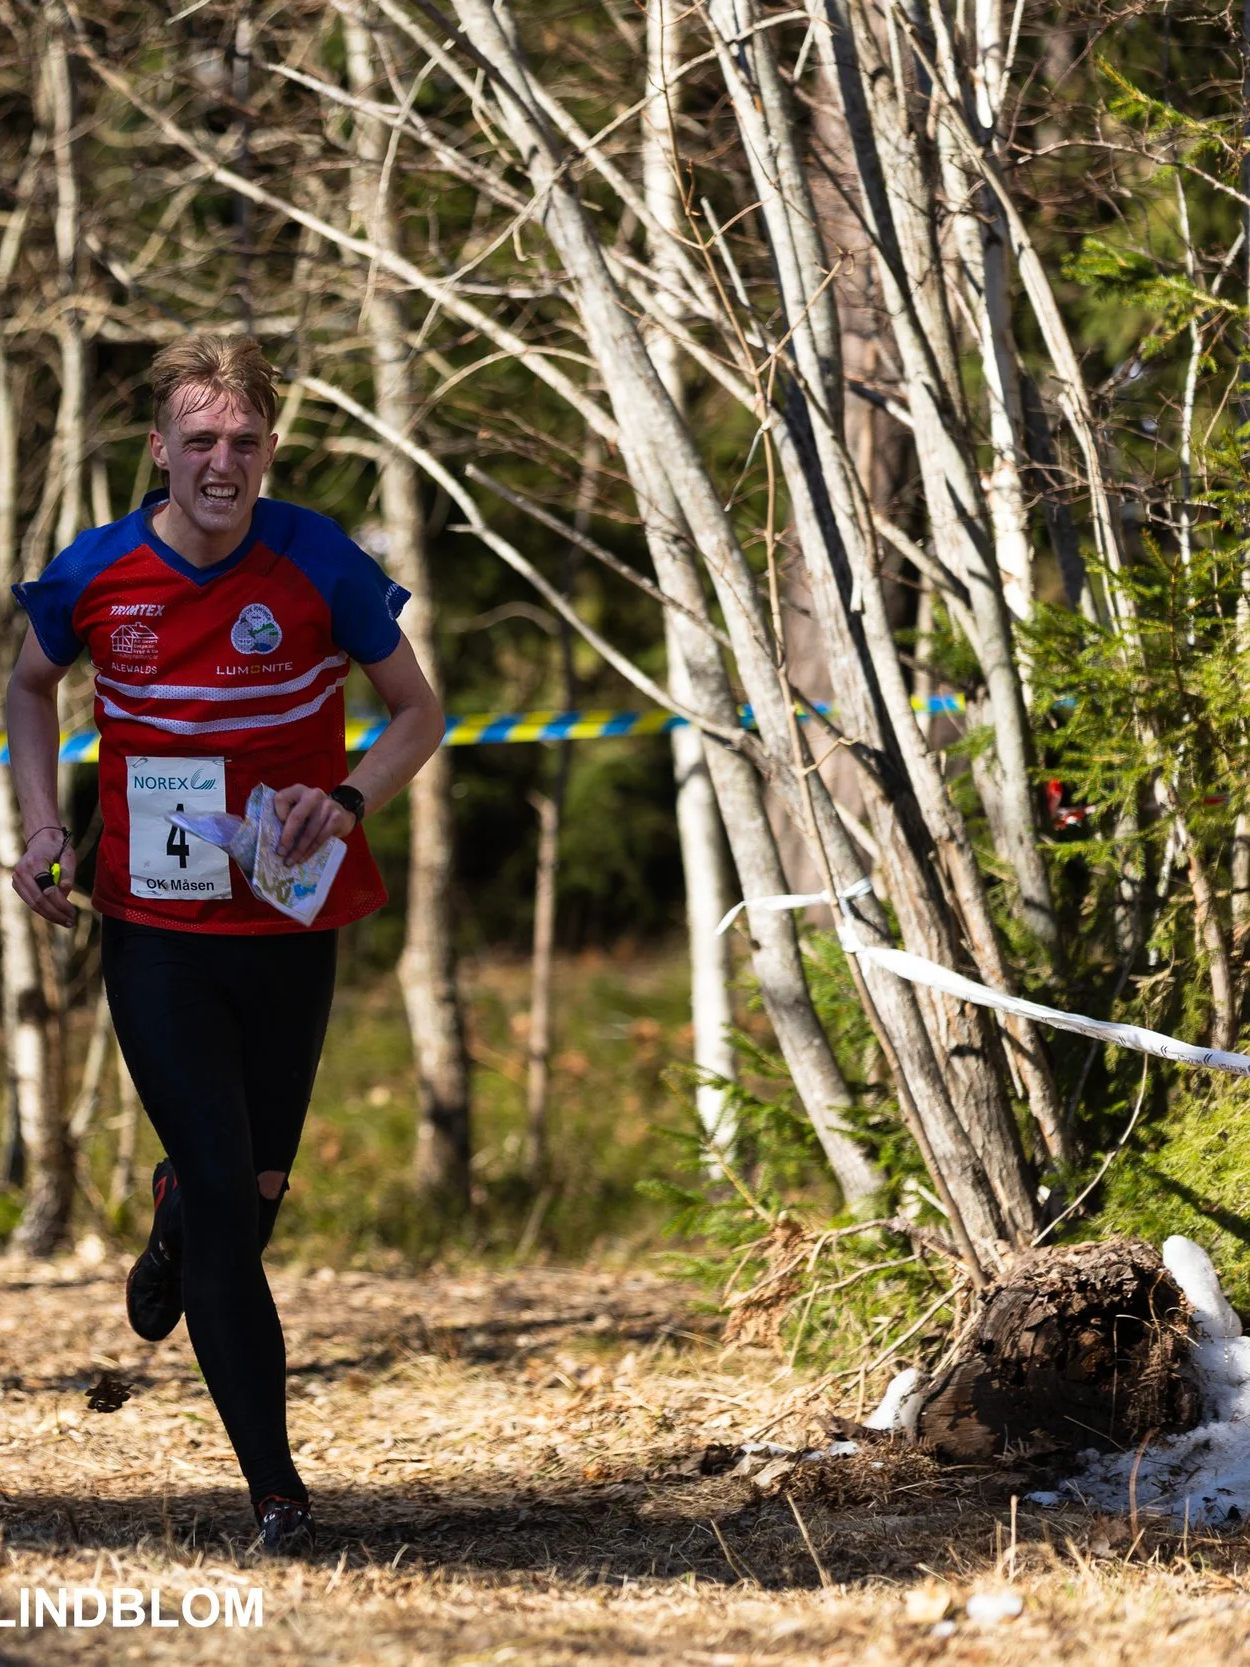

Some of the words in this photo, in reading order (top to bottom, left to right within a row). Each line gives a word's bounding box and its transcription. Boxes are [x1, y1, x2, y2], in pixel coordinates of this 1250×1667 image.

[110, 604, 165, 617] TRIMTEX
[111, 662, 158, 675] ALEWALDS
[216, 661, 294, 676] LUMONITE
[133, 775, 189, 790] NOREX
[165, 803, 190, 869] 4
[146, 878, 167, 890] OK
[170, 878, 215, 891] Måsen
